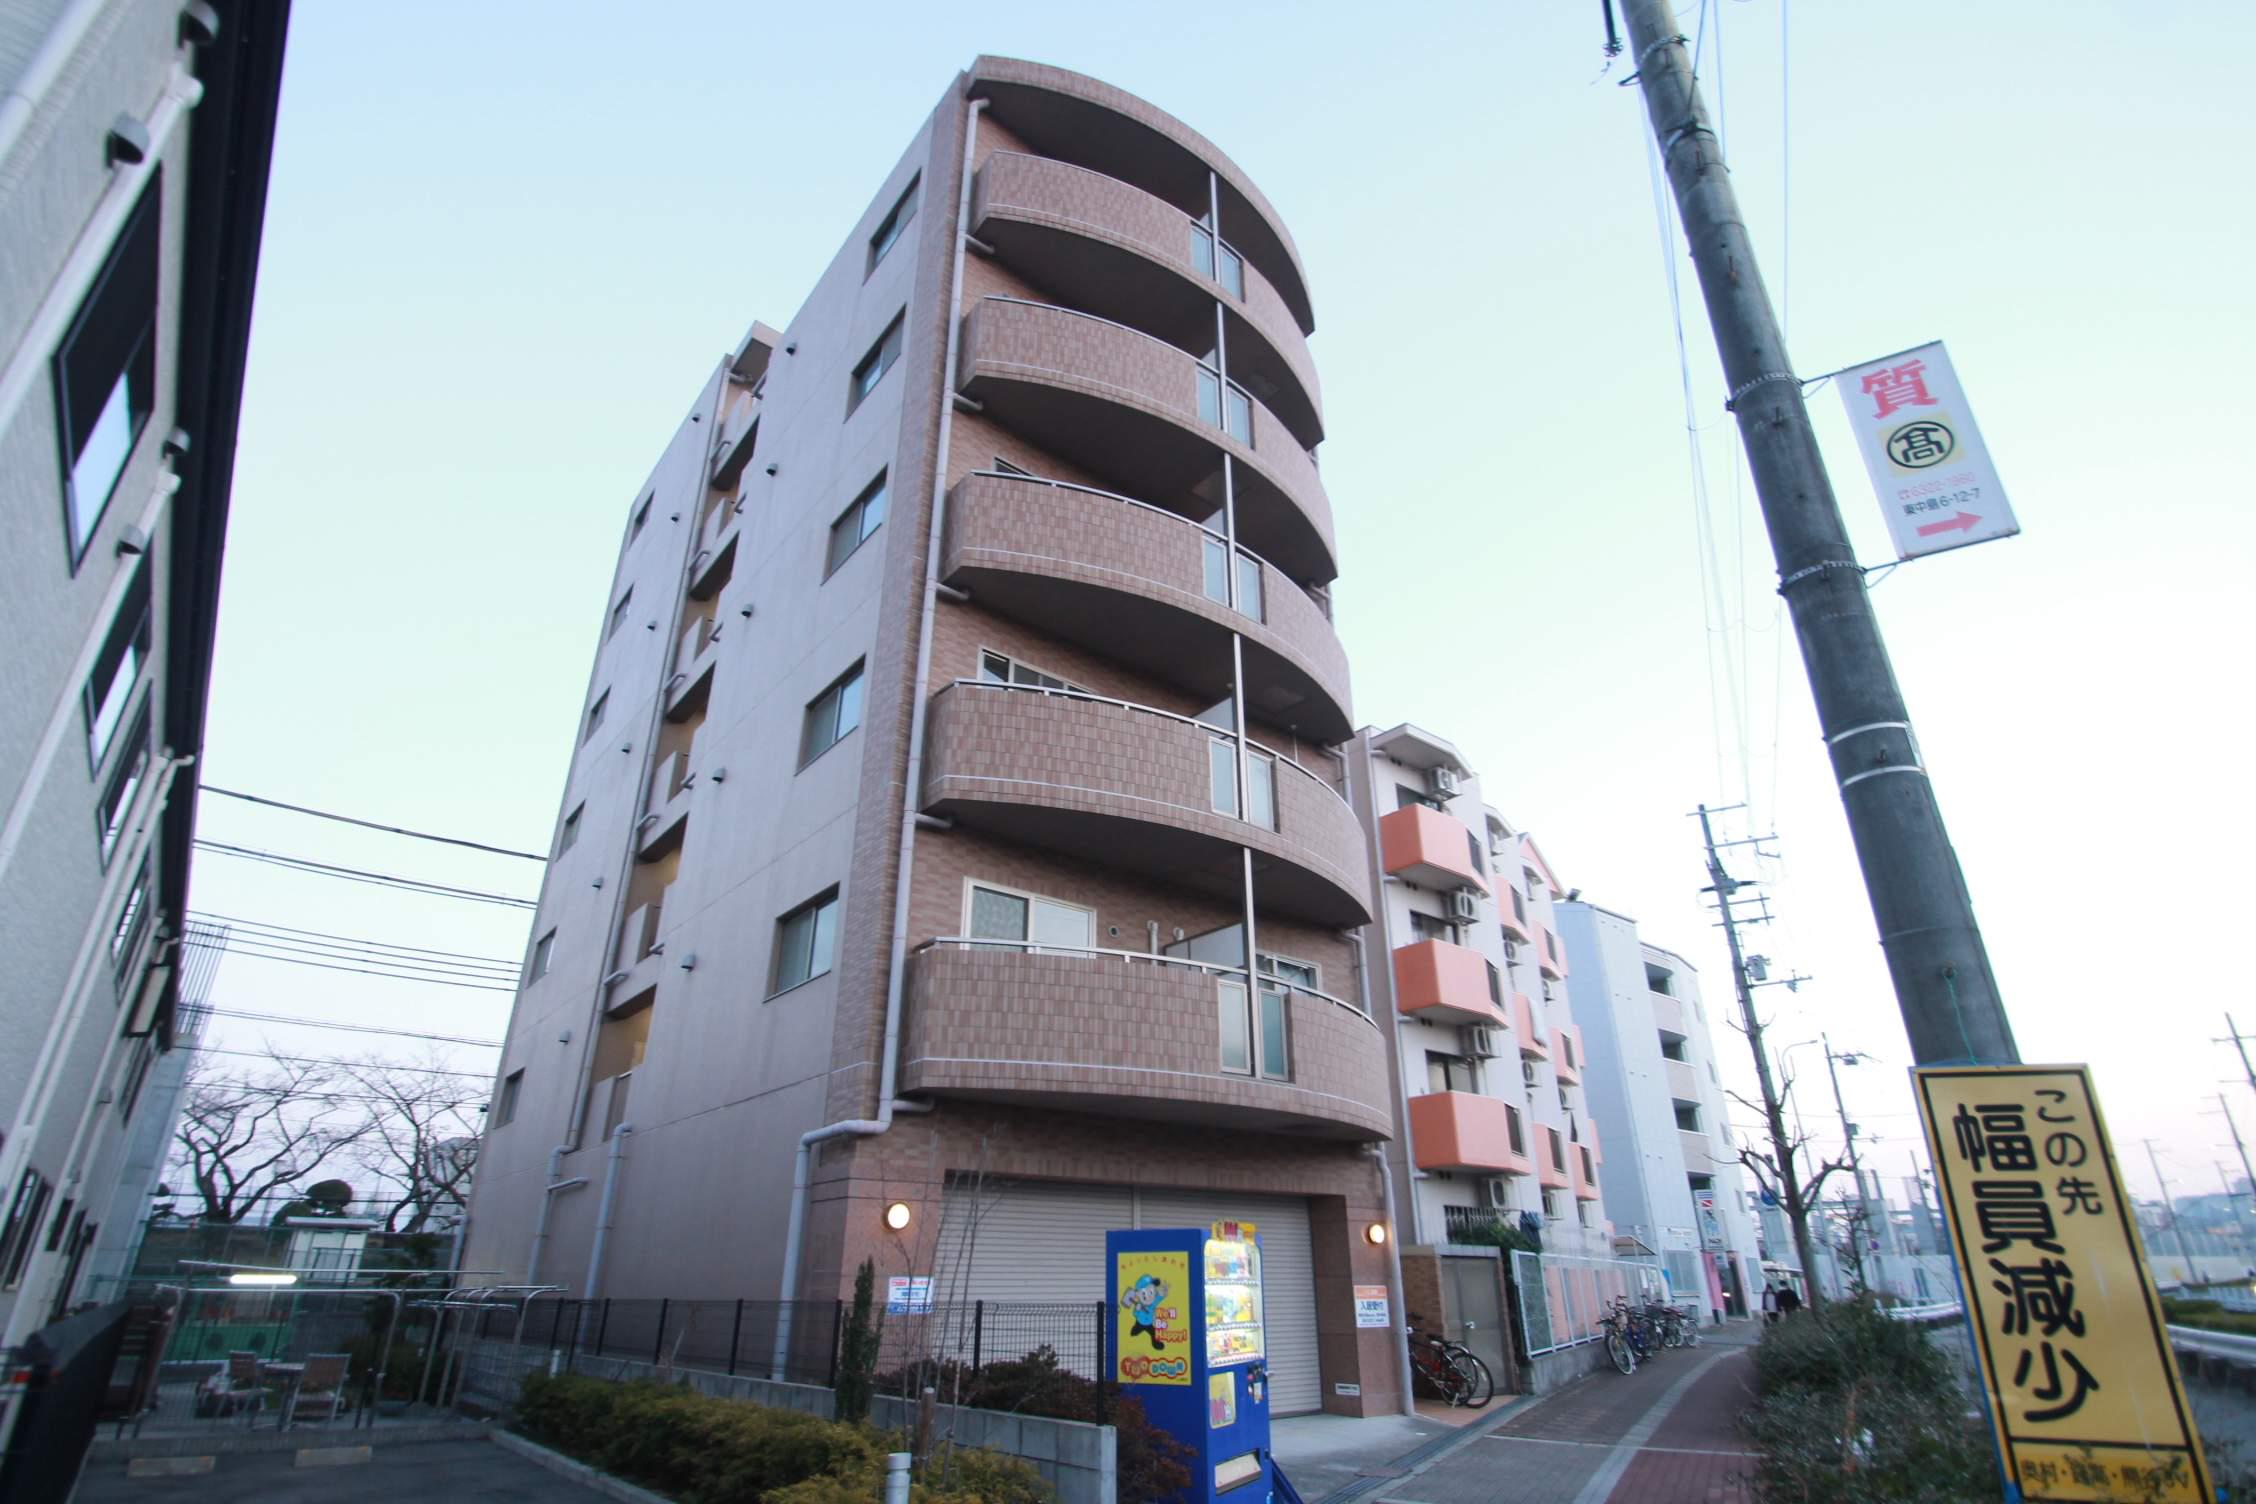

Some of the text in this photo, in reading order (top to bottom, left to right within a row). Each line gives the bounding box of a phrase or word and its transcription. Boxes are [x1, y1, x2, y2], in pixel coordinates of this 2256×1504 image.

[1861, 359, 1938, 420] 質
[2034, 1089, 2103, 1215] この先
[1952, 1103, 2099, 1422] 幅員減少
[1155, 1320, 1168, 1329] Be
[1155, 1330, 1187, 1343] Happy!
